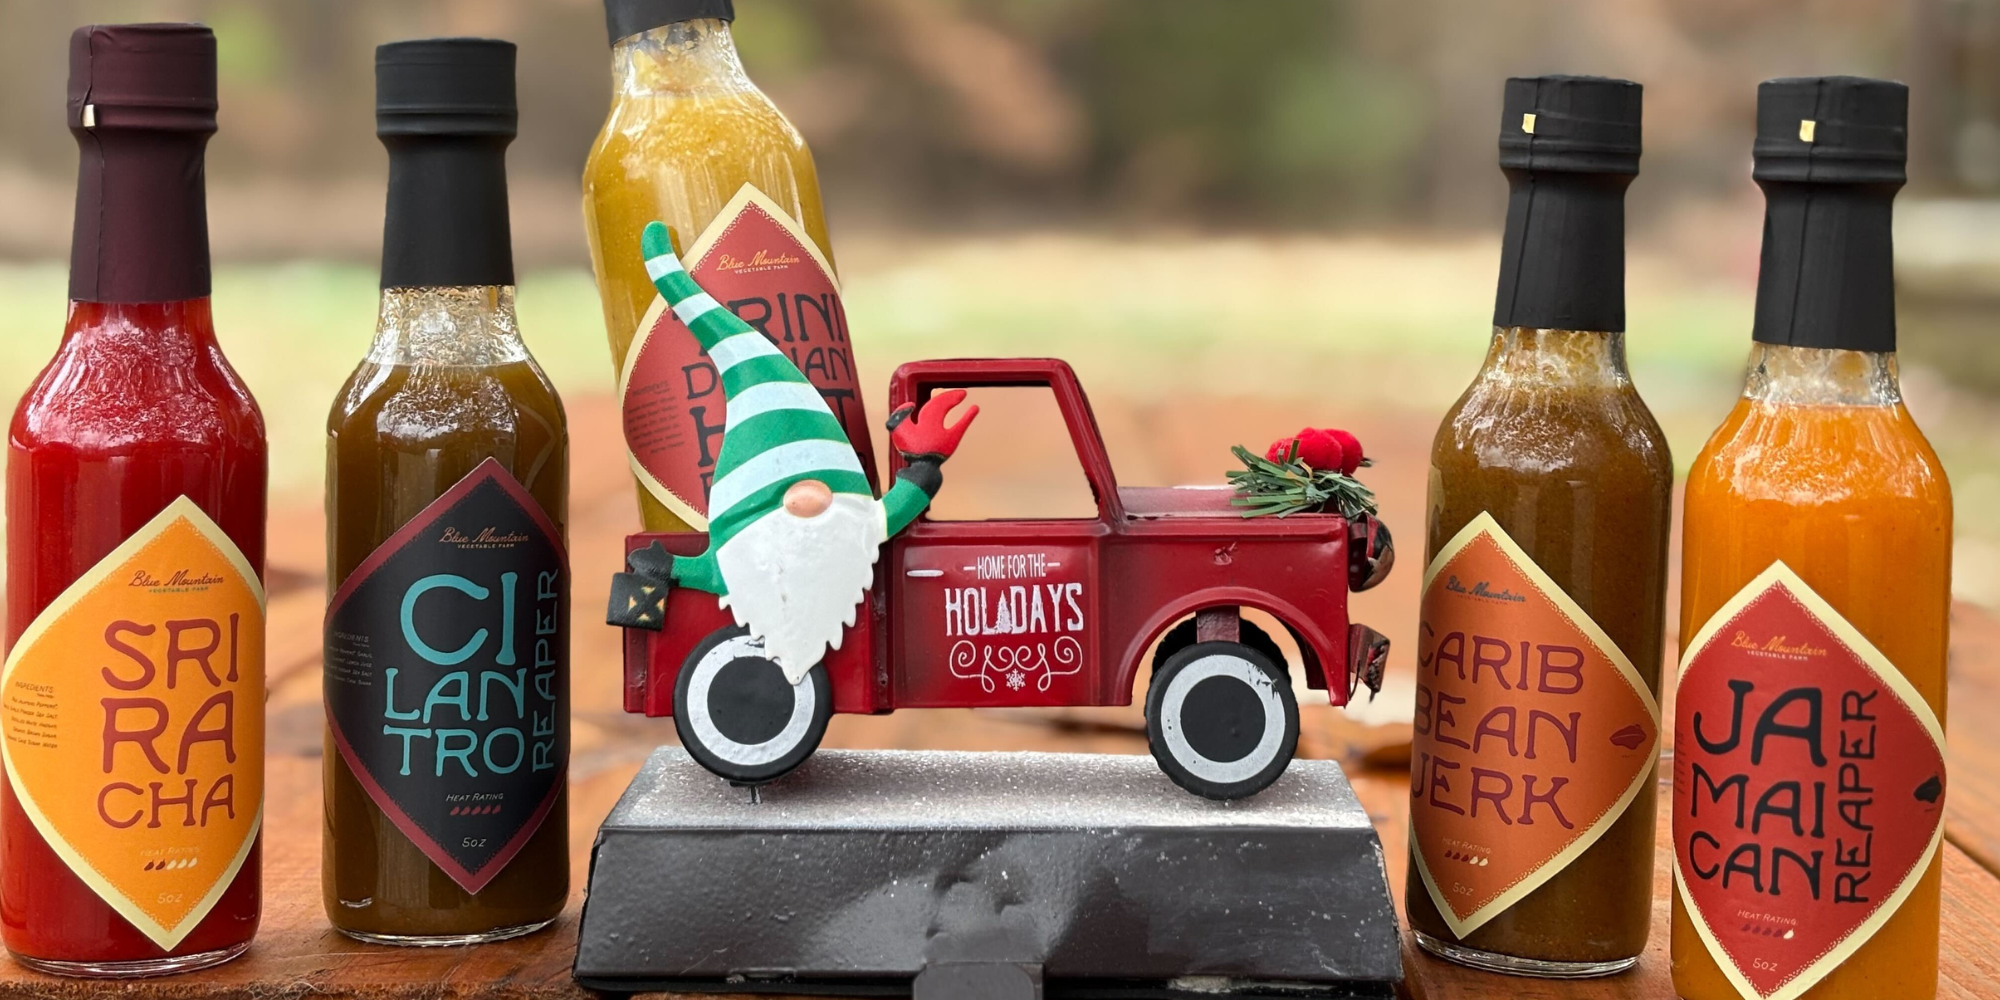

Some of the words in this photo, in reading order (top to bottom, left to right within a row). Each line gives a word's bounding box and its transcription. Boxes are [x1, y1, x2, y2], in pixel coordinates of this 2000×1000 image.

[716, 253, 745, 271] Blue
[747, 249, 800, 267] Mountain
[734, 265, 772, 274] VEGETABLE
[672, 292, 844, 356] RINI
[439, 526, 469, 543] Blue
[472, 526, 529, 543] Mountain
[128, 570, 160, 587] Blue
[164, 569, 224, 586] Mountain
[977, 555, 1005, 580] HOME
[1007, 554, 1026, 579] FOR
[1027, 553, 1046, 577] THE
[1446, 575, 1466, 593] Blue
[1469, 582, 1526, 602] Mountain
[400, 571, 519, 666] CI
[1731, 630, 1758, 650] Blue
[1761, 635, 1827, 656] Mountain
[101, 612, 239, 690] SRI
[532, 568, 559, 773] REAPER
[1418, 620, 1585, 695] CARIB
[1747, 650, 1786, 659] VEGETABLE
[384, 667, 528, 724] LAN
[1693, 679, 1827, 766] JA
[101, 690, 237, 774] RA
[383, 725, 525, 777] TRO
[1414, 684, 1581, 763] BEAN
[97, 774, 235, 828] CHA
[445, 794, 471, 802] HEAT
[472, 792, 504, 802] RATING
[1411, 751, 1575, 830] JERK
[1690, 762, 1825, 838] MAI
[1834, 688, 1878, 904] REAPER
[1462, 841, 1491, 855] RATING
[1689, 830, 1824, 900] CAN
[1737, 910, 1760, 920] HEAT
[1762, 914, 1797, 926] RATING
